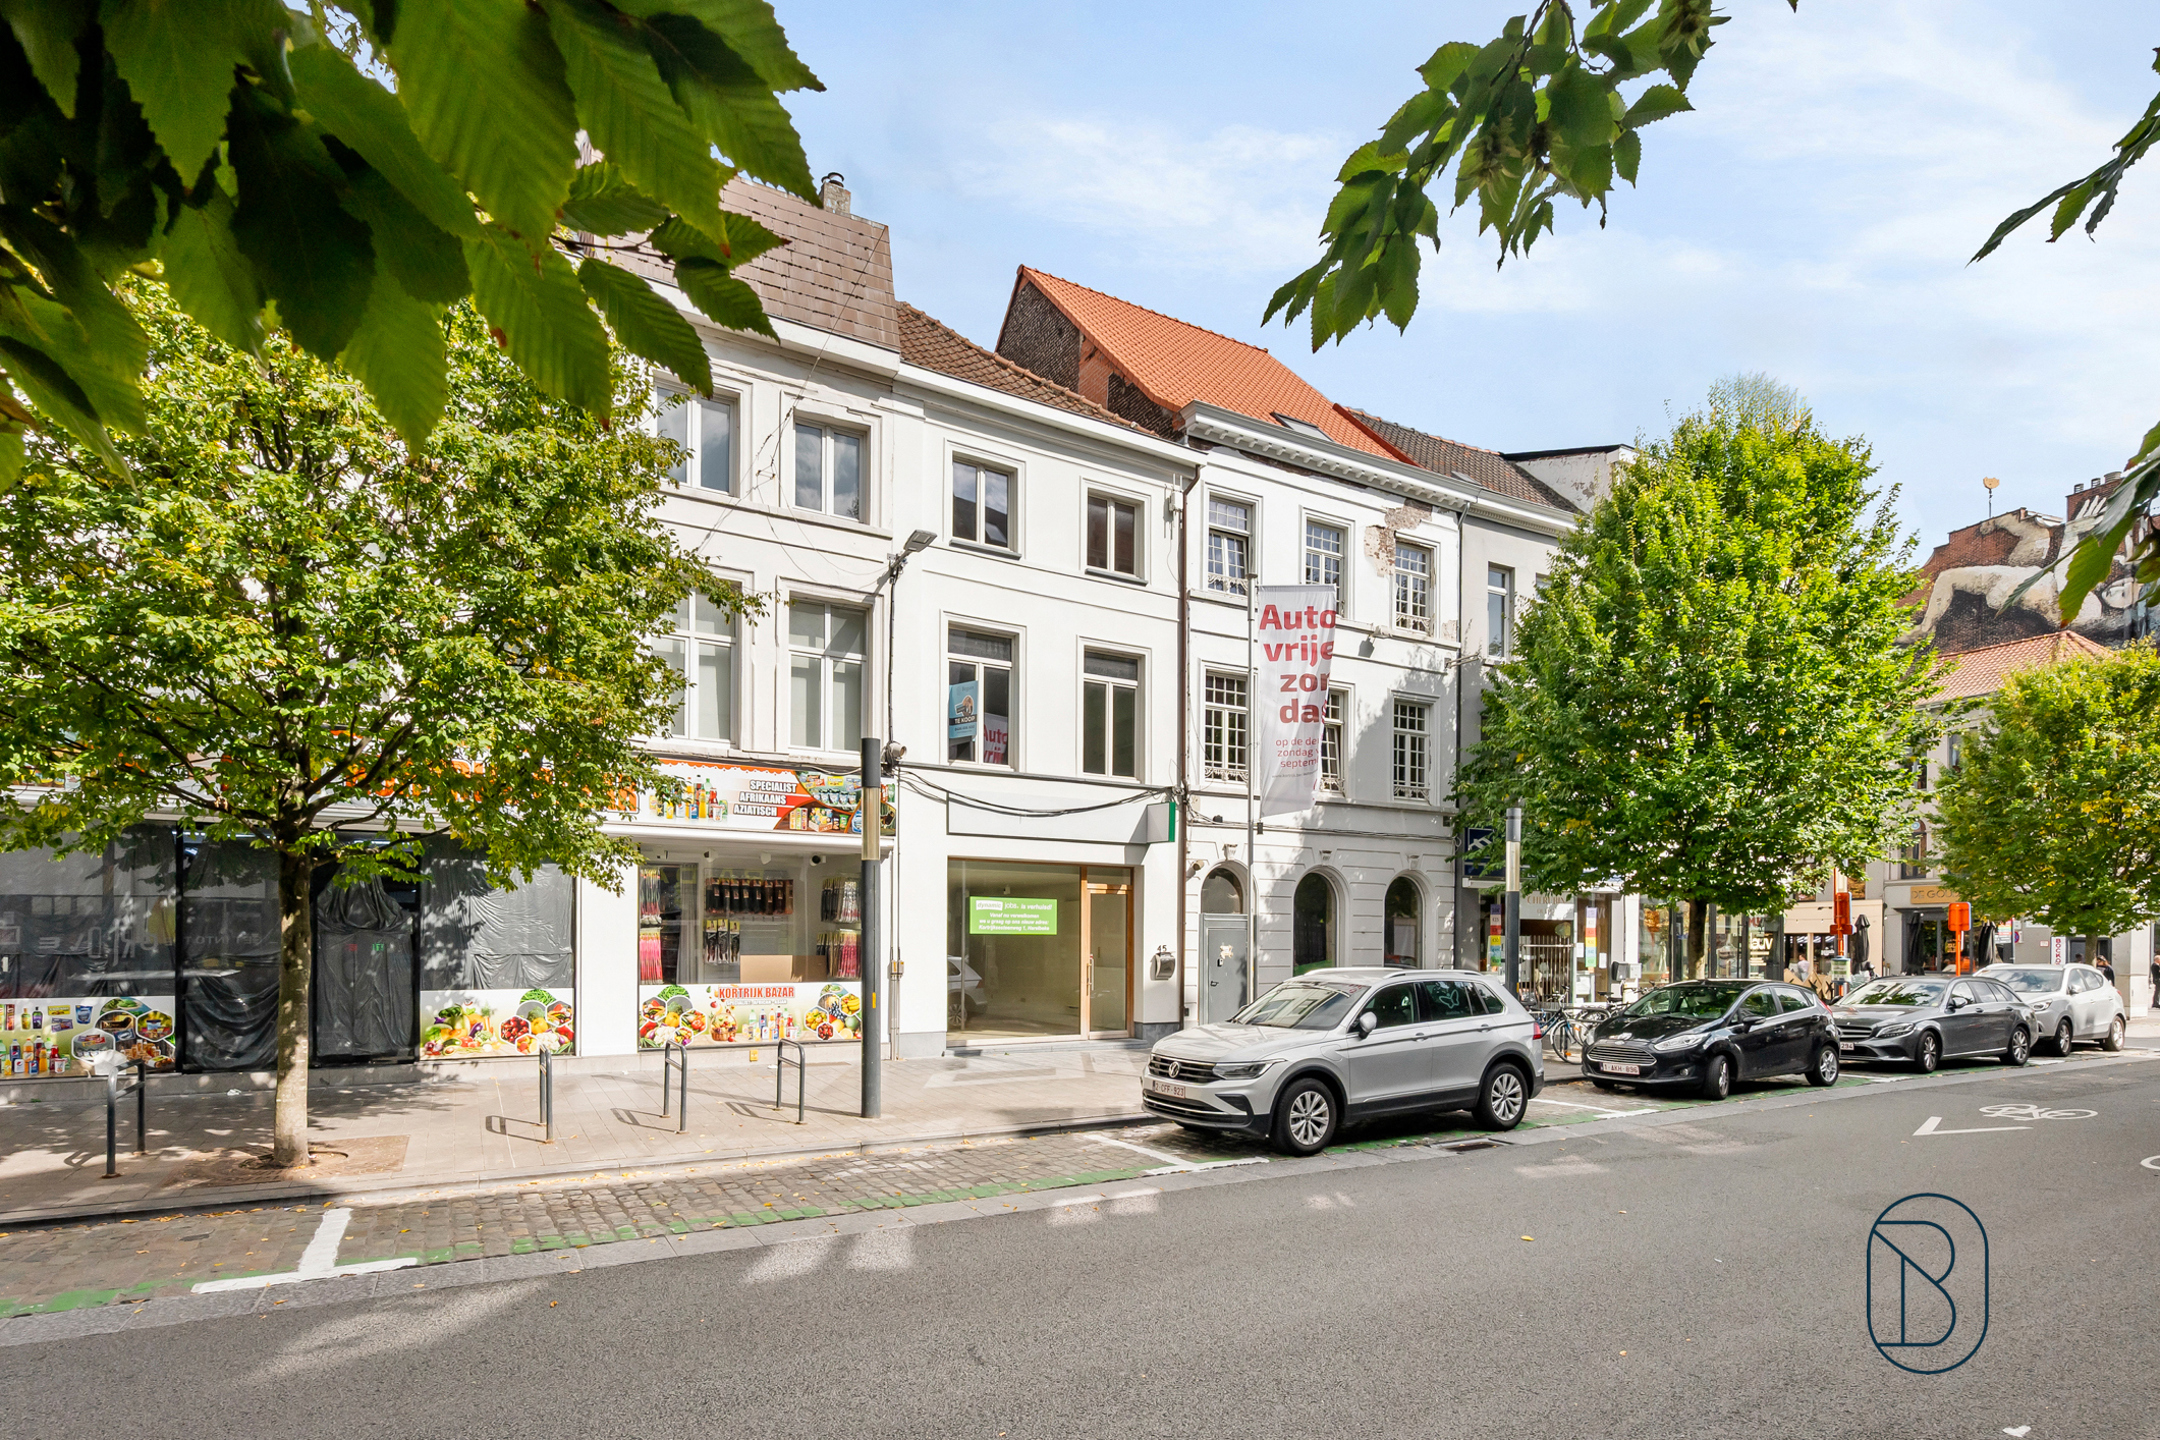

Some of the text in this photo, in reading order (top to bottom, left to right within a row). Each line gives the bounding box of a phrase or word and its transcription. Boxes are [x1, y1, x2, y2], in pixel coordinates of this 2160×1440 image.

[1259, 604, 1336, 630] Auto
[1263, 634, 1334, 667] vrije
[1275, 737, 1319, 748] op de de
[1277, 748, 1314, 758] zondag
[1280, 756, 1318, 769] septem
[749, 779, 797, 794] SPECIALIST
[739, 791, 787, 806] AFRIKAANS
[732, 803, 778, 817] AZIATISCH
[1157, 944, 1167, 952] 45
[719, 987, 794, 999] KORTRIJK BAZAR
